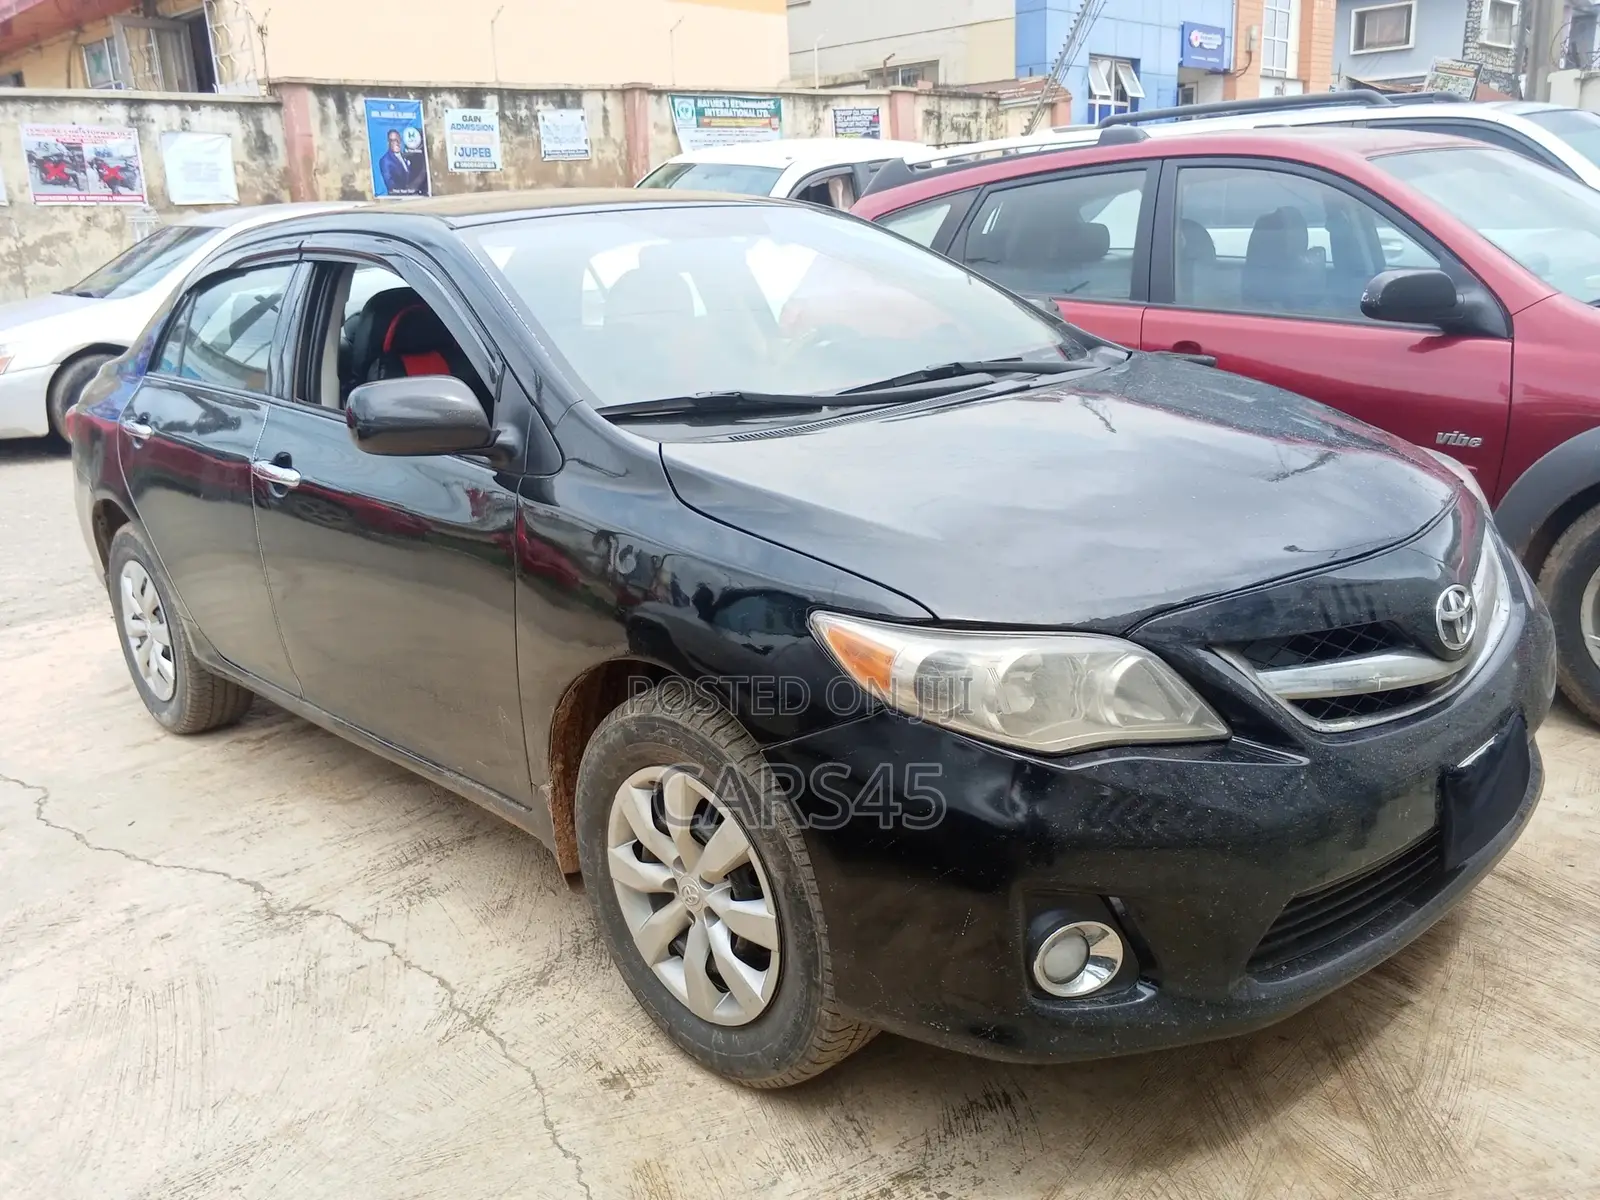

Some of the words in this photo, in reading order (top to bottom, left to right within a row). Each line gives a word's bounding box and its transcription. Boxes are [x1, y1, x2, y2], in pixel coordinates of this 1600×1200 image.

[704, 108, 755, 117] INTERNATIONAL
[451, 123, 494, 131] ADMISSION
[458, 147, 491, 158] JUPEB
[1436, 430, 1482, 447] vibe
